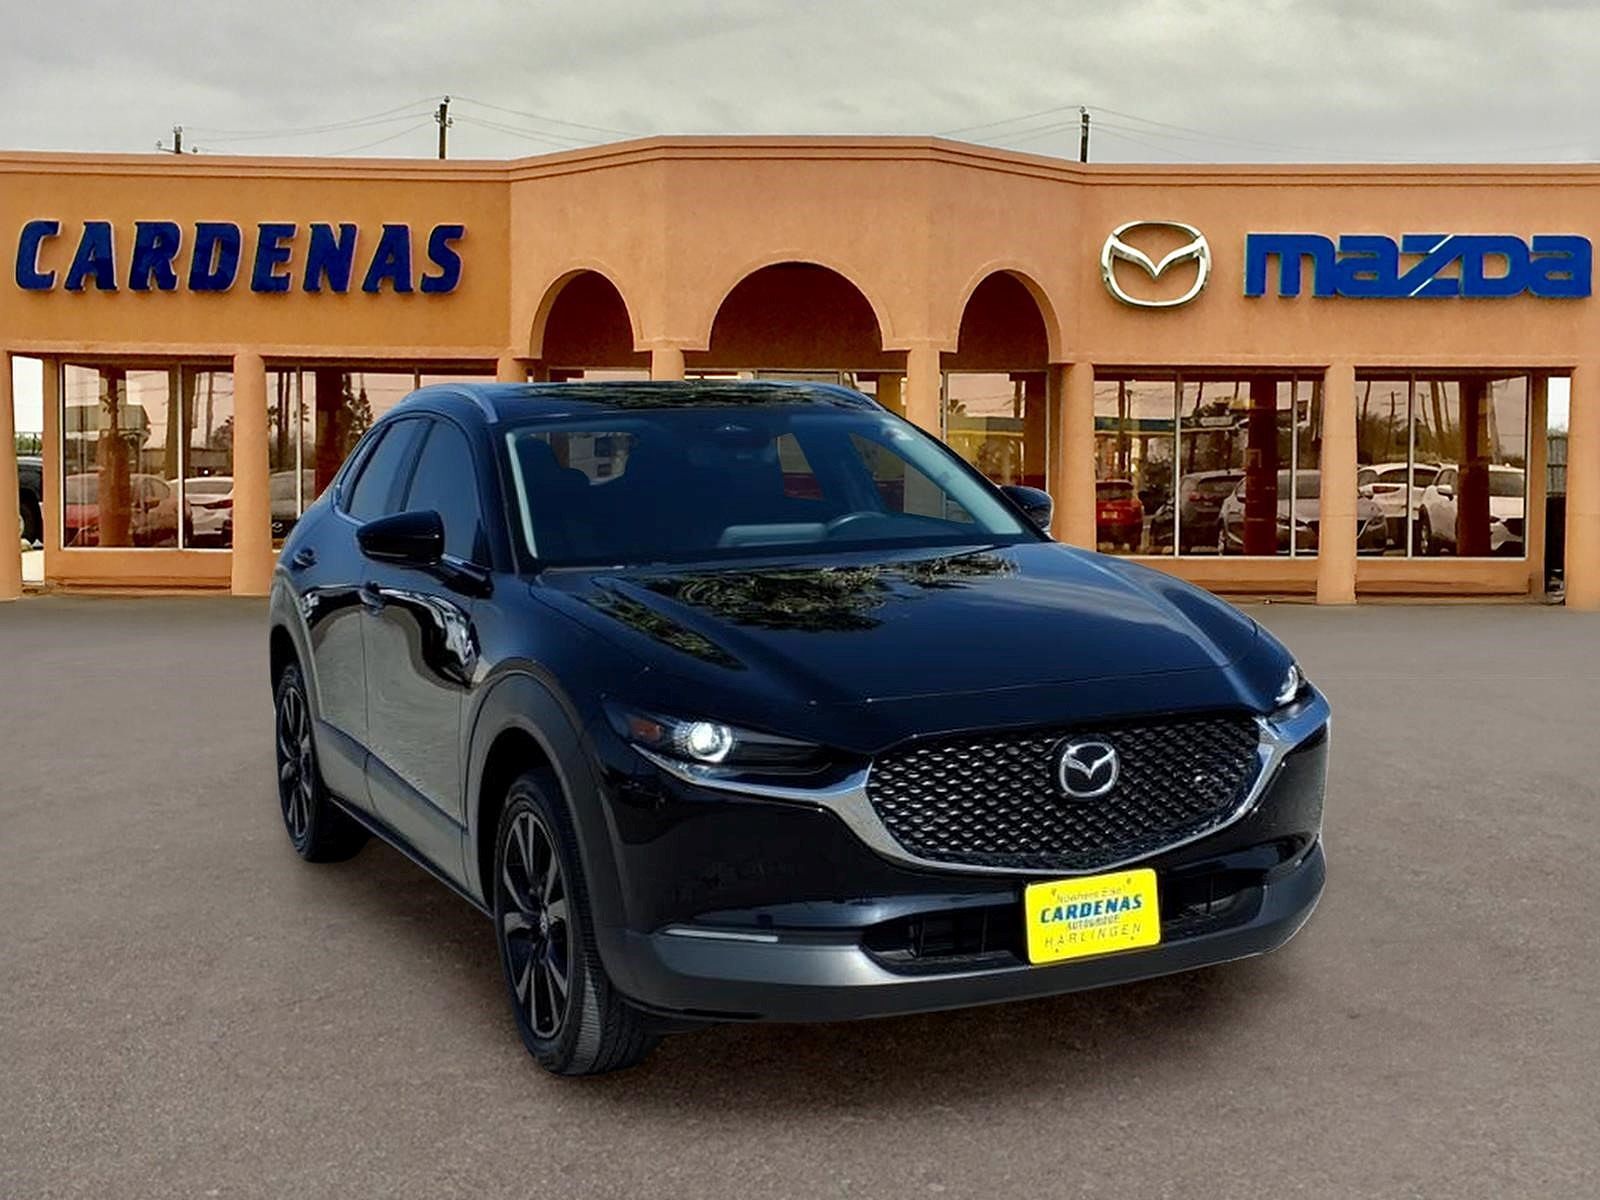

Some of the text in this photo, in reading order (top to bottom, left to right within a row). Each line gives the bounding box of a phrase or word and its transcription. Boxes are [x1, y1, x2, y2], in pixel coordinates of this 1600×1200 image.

[15, 219, 467, 294] CARDENAS
[1040, 893, 1143, 923] CARDENAS
[1044, 922, 1142, 948] HARLINGEN
